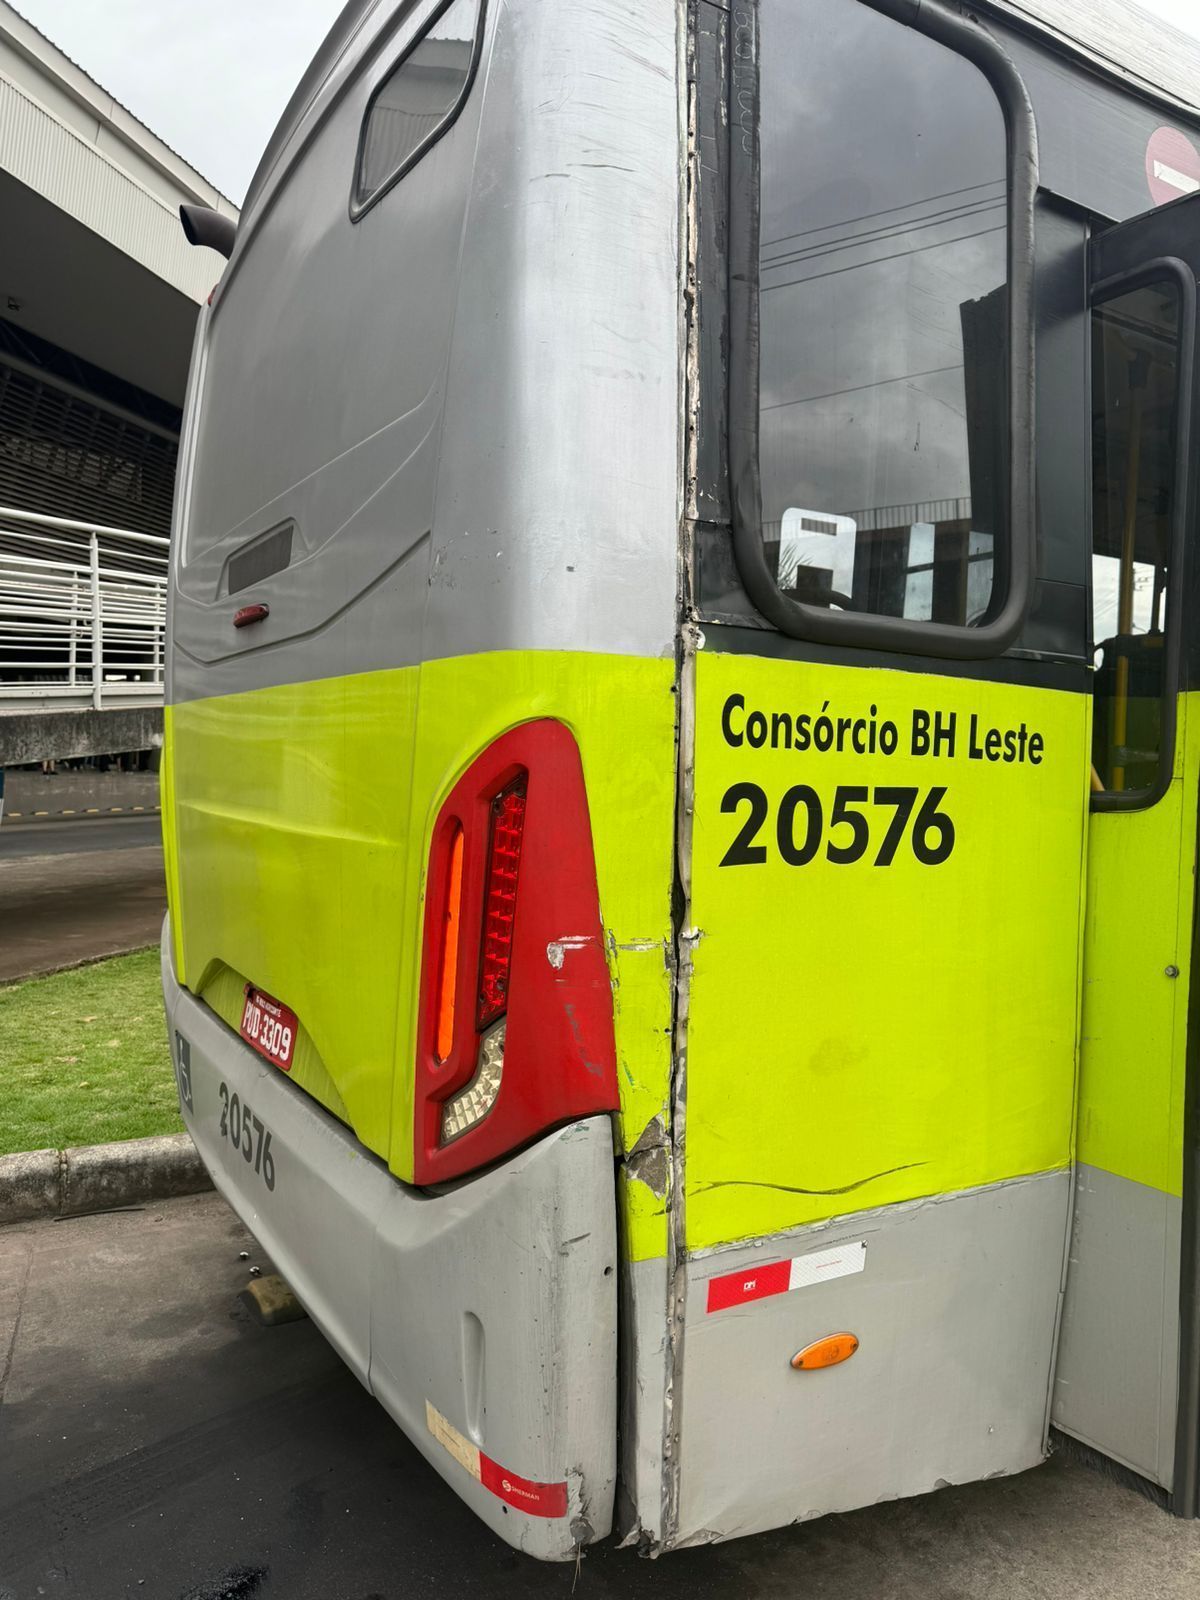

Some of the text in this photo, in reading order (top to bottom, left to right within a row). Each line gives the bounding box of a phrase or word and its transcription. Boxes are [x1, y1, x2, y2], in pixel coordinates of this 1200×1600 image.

[721, 693, 1045, 765] Consórcio BH Leste
[718, 782, 956, 867] 20576
[219, 1081, 275, 1192] 20576
